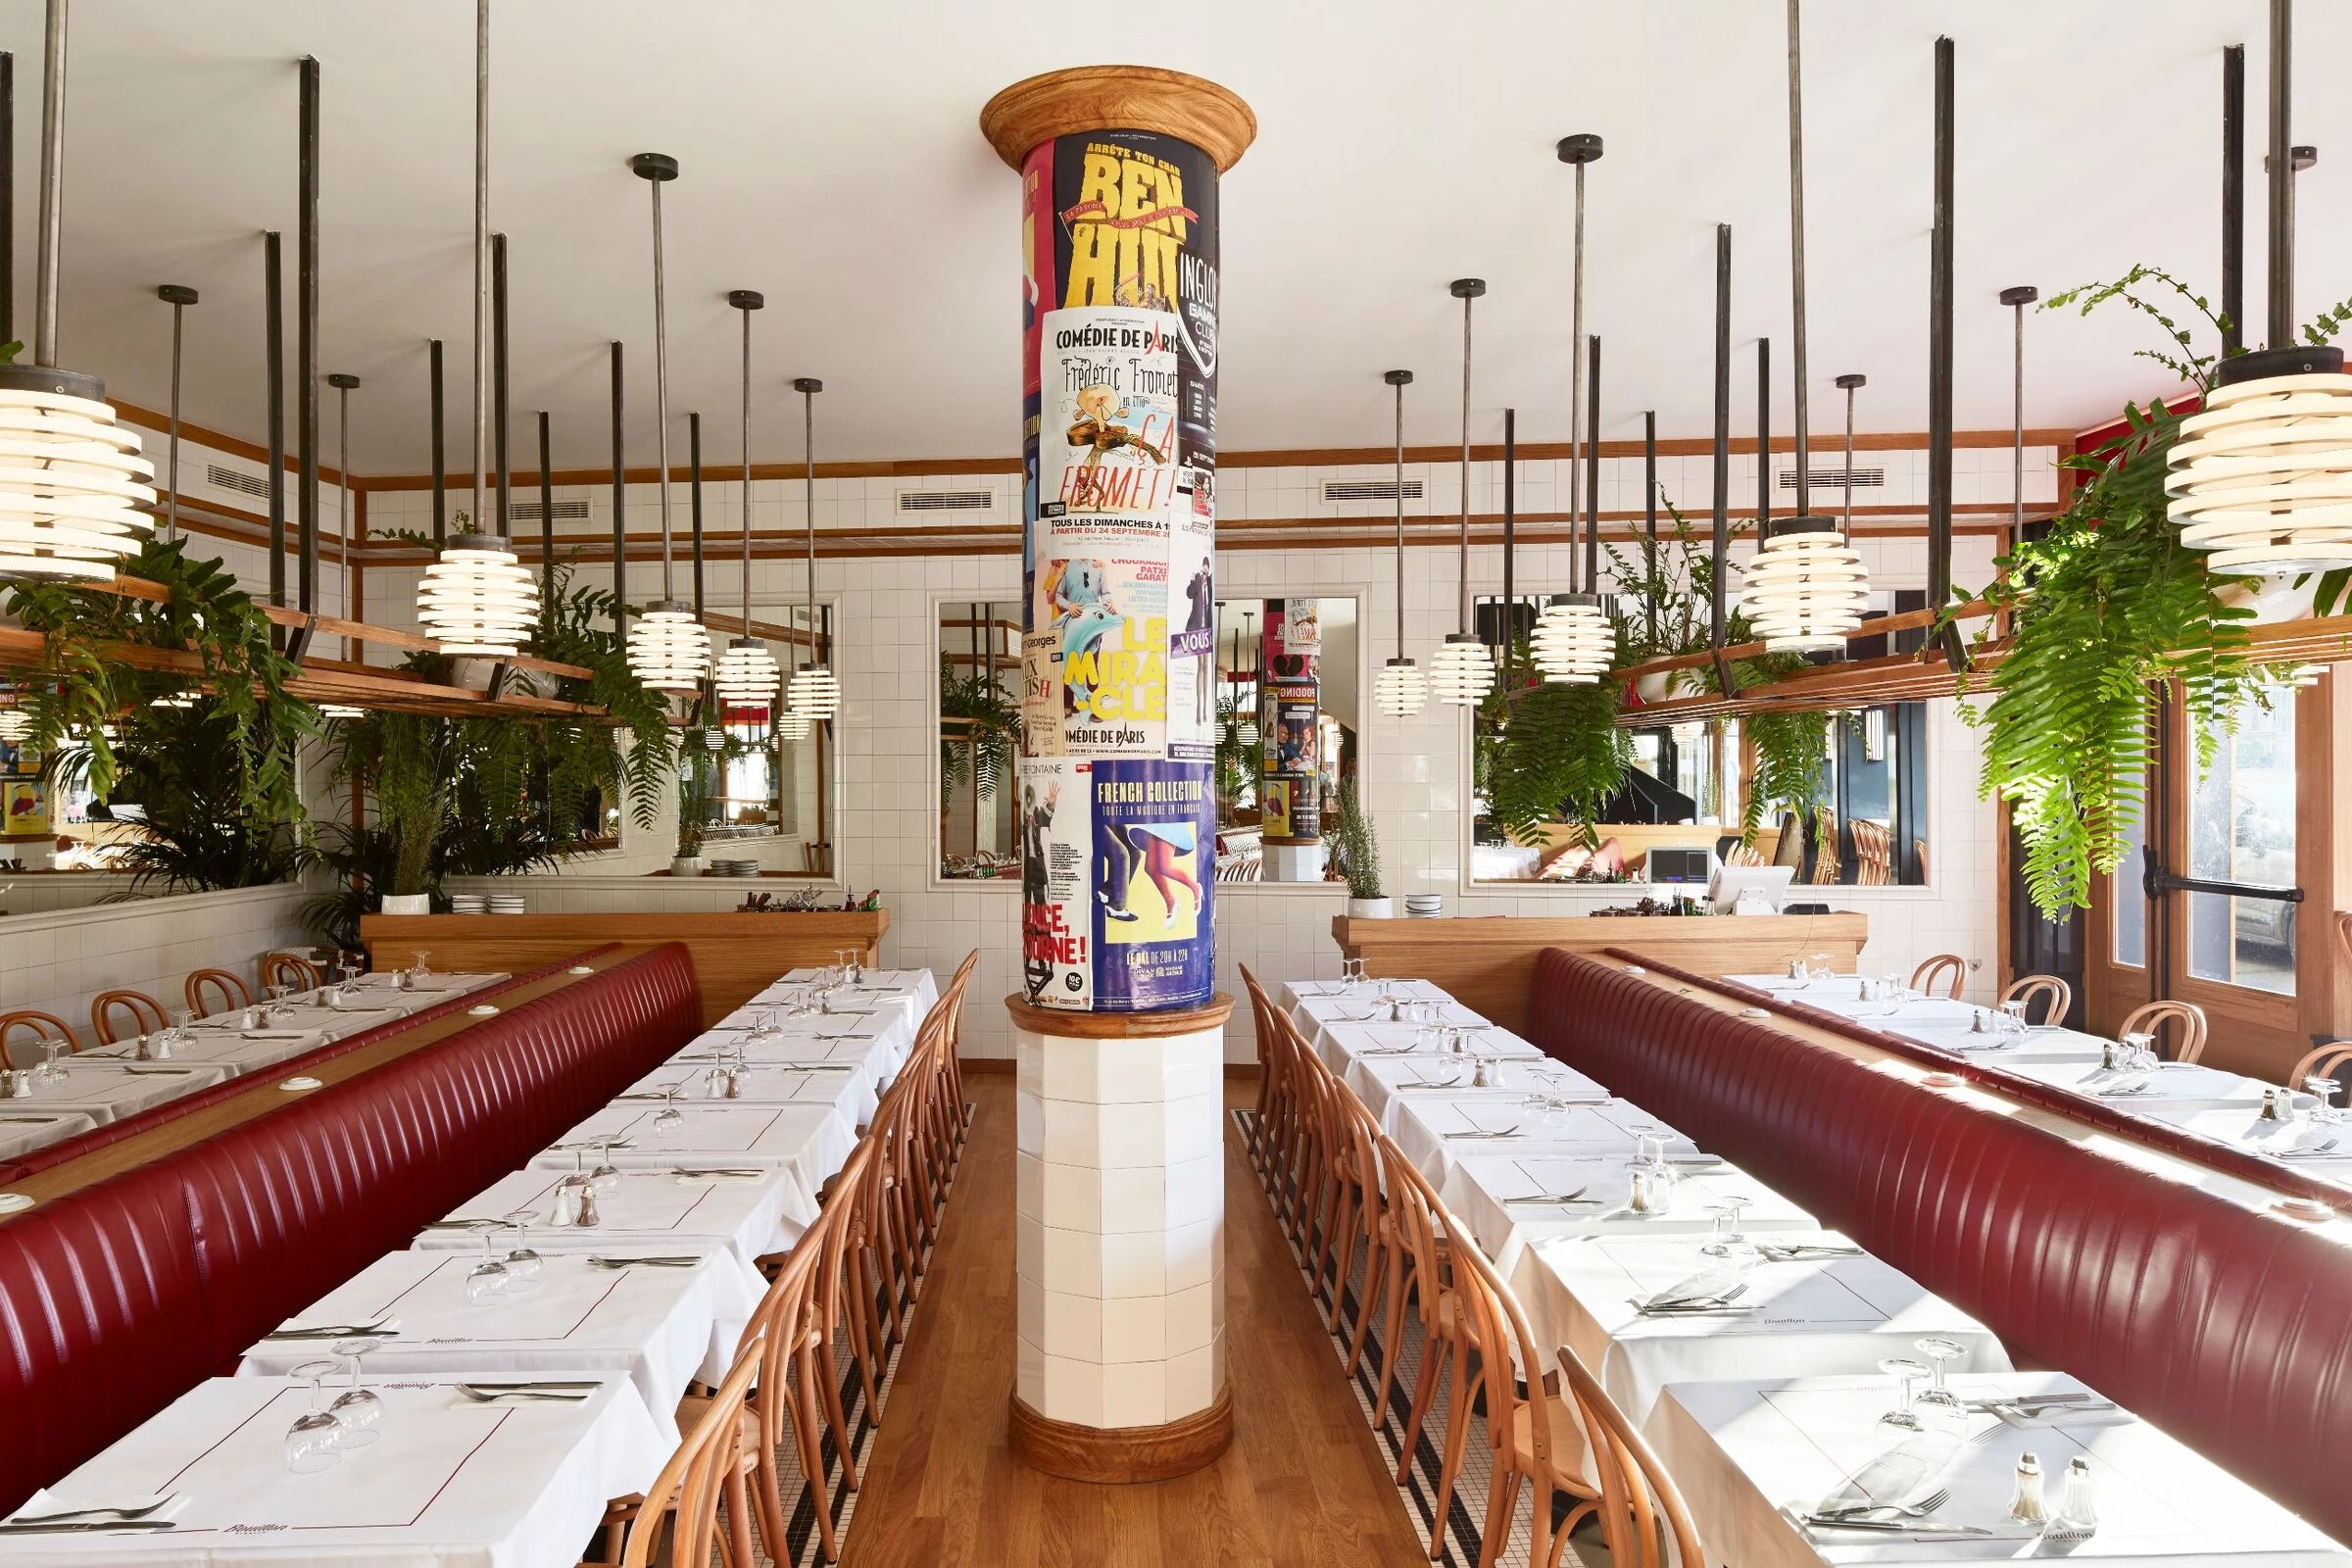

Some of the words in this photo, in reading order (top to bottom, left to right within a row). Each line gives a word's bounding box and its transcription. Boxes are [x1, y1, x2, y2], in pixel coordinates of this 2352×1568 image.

[1087, 143, 1131, 158] ARRÊTE
[1135, 151, 1155, 166] TON
[1158, 159, 1181, 176] CHAR
[1075, 203, 1102, 214] PARODIE
[1078, 153, 1187, 242] BEN
[1056, 323, 1117, 349] COMÉDIE
[1122, 328, 1140, 348] DE
[1061, 356, 1120, 392] Frédéric
[1129, 358, 1178, 397] Fromet
[1138, 414, 1173, 466] ÇA
[1094, 518, 1153, 528] DIMANCHES
[1111, 527, 1161, 537] SEPTEMBRE
[1136, 572, 1167, 581] GARAT
[1123, 616, 1166, 653] LE
[1181, 632, 1209, 654] VOUS
[1063, 651, 1166, 686] MIRA
[1101, 730, 1113, 743] DE
[1116, 721, 1145, 748] PARIS
[1098, 782, 1144, 803] FRENCH
[1148, 780, 1202, 802] COLLECTION
[1102, 806, 1123, 815] TOUTE
[1126, 806, 1134, 815] LA
[1137, 805, 1166, 815] MUSIQUE
[1168, 805, 1175, 814] EN
[1151, 951, 1158, 964] DE
